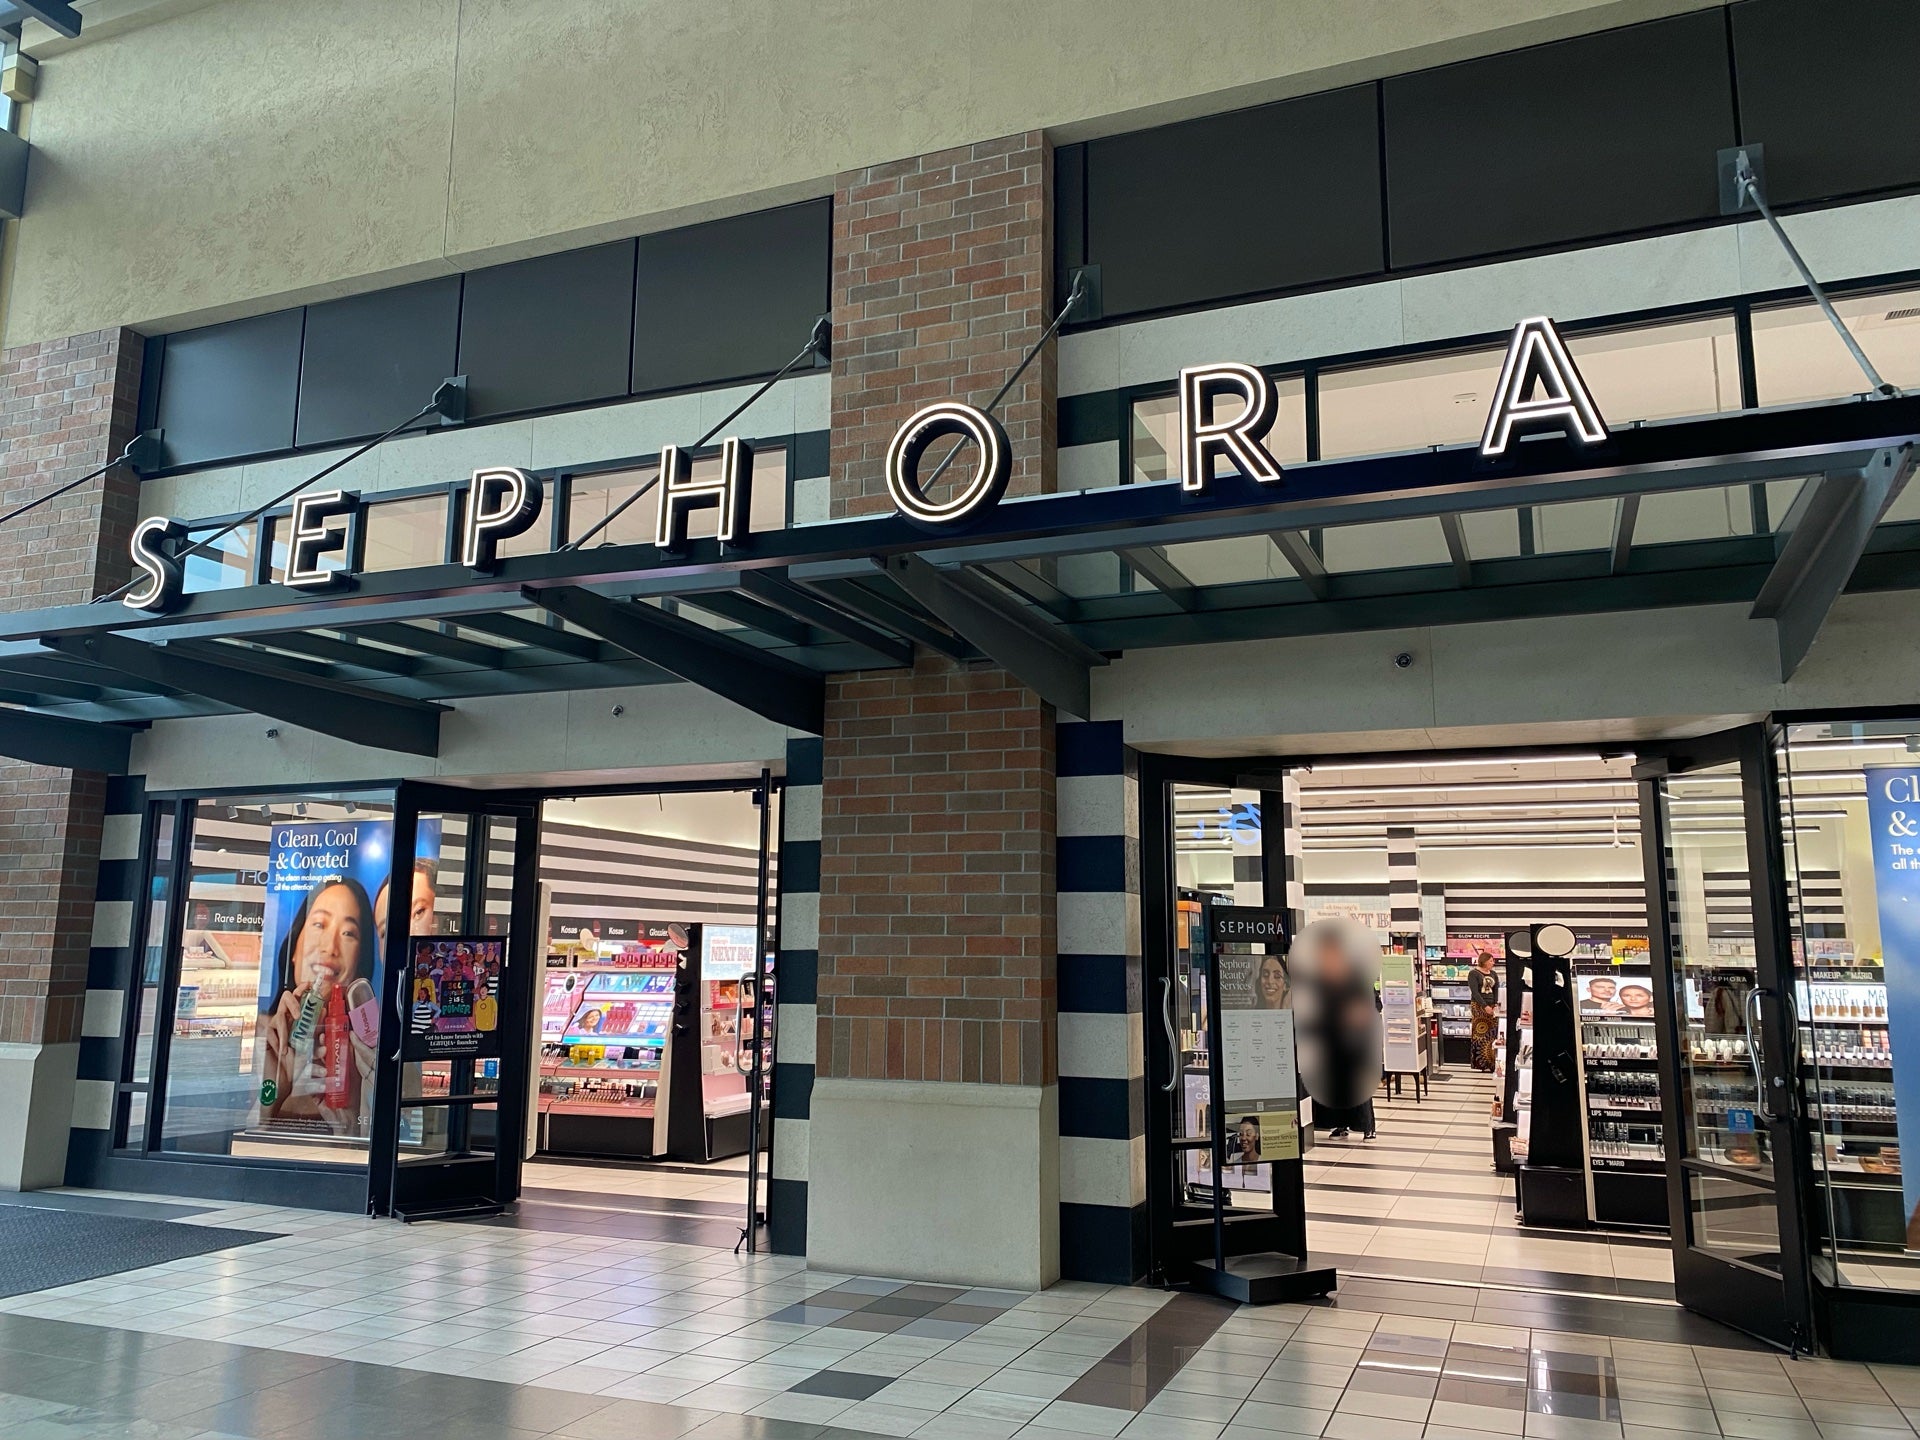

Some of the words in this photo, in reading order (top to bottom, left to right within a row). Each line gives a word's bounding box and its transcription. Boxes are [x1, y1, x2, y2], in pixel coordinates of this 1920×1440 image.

[122, 316, 1608, 611] SEPHORA
[1888, 810, 1918, 837] &
[278, 830, 322, 850] Clean,
[324, 827, 358, 847] Cool
[1890, 844, 1914, 856] The
[276, 852, 288, 870] &
[290, 850, 349, 870] Coveted
[1892, 858, 1907, 870] all
[276, 874, 284, 882] The
[285, 874, 300, 882] clean
[301, 873, 322, 883] makeup
[322, 874, 342, 883] getting
[214, 912, 234, 923] Rare
[236, 913, 264, 927] Beauty
[560, 925, 578, 934] Kosas
[608, 927, 624, 935] Kosas
[1220, 920, 1284, 935] SEPHORA
[711, 946, 736, 962] NEXT
[737, 946, 754, 962] BIG
[1220, 959, 1251, 970] Sephora
[1220, 970, 1247, 981] Beauty
[1813, 971, 1840, 979] MAKEUP
[1851, 972, 1873, 980] MARIO
[1220, 981, 1252, 991] Services
